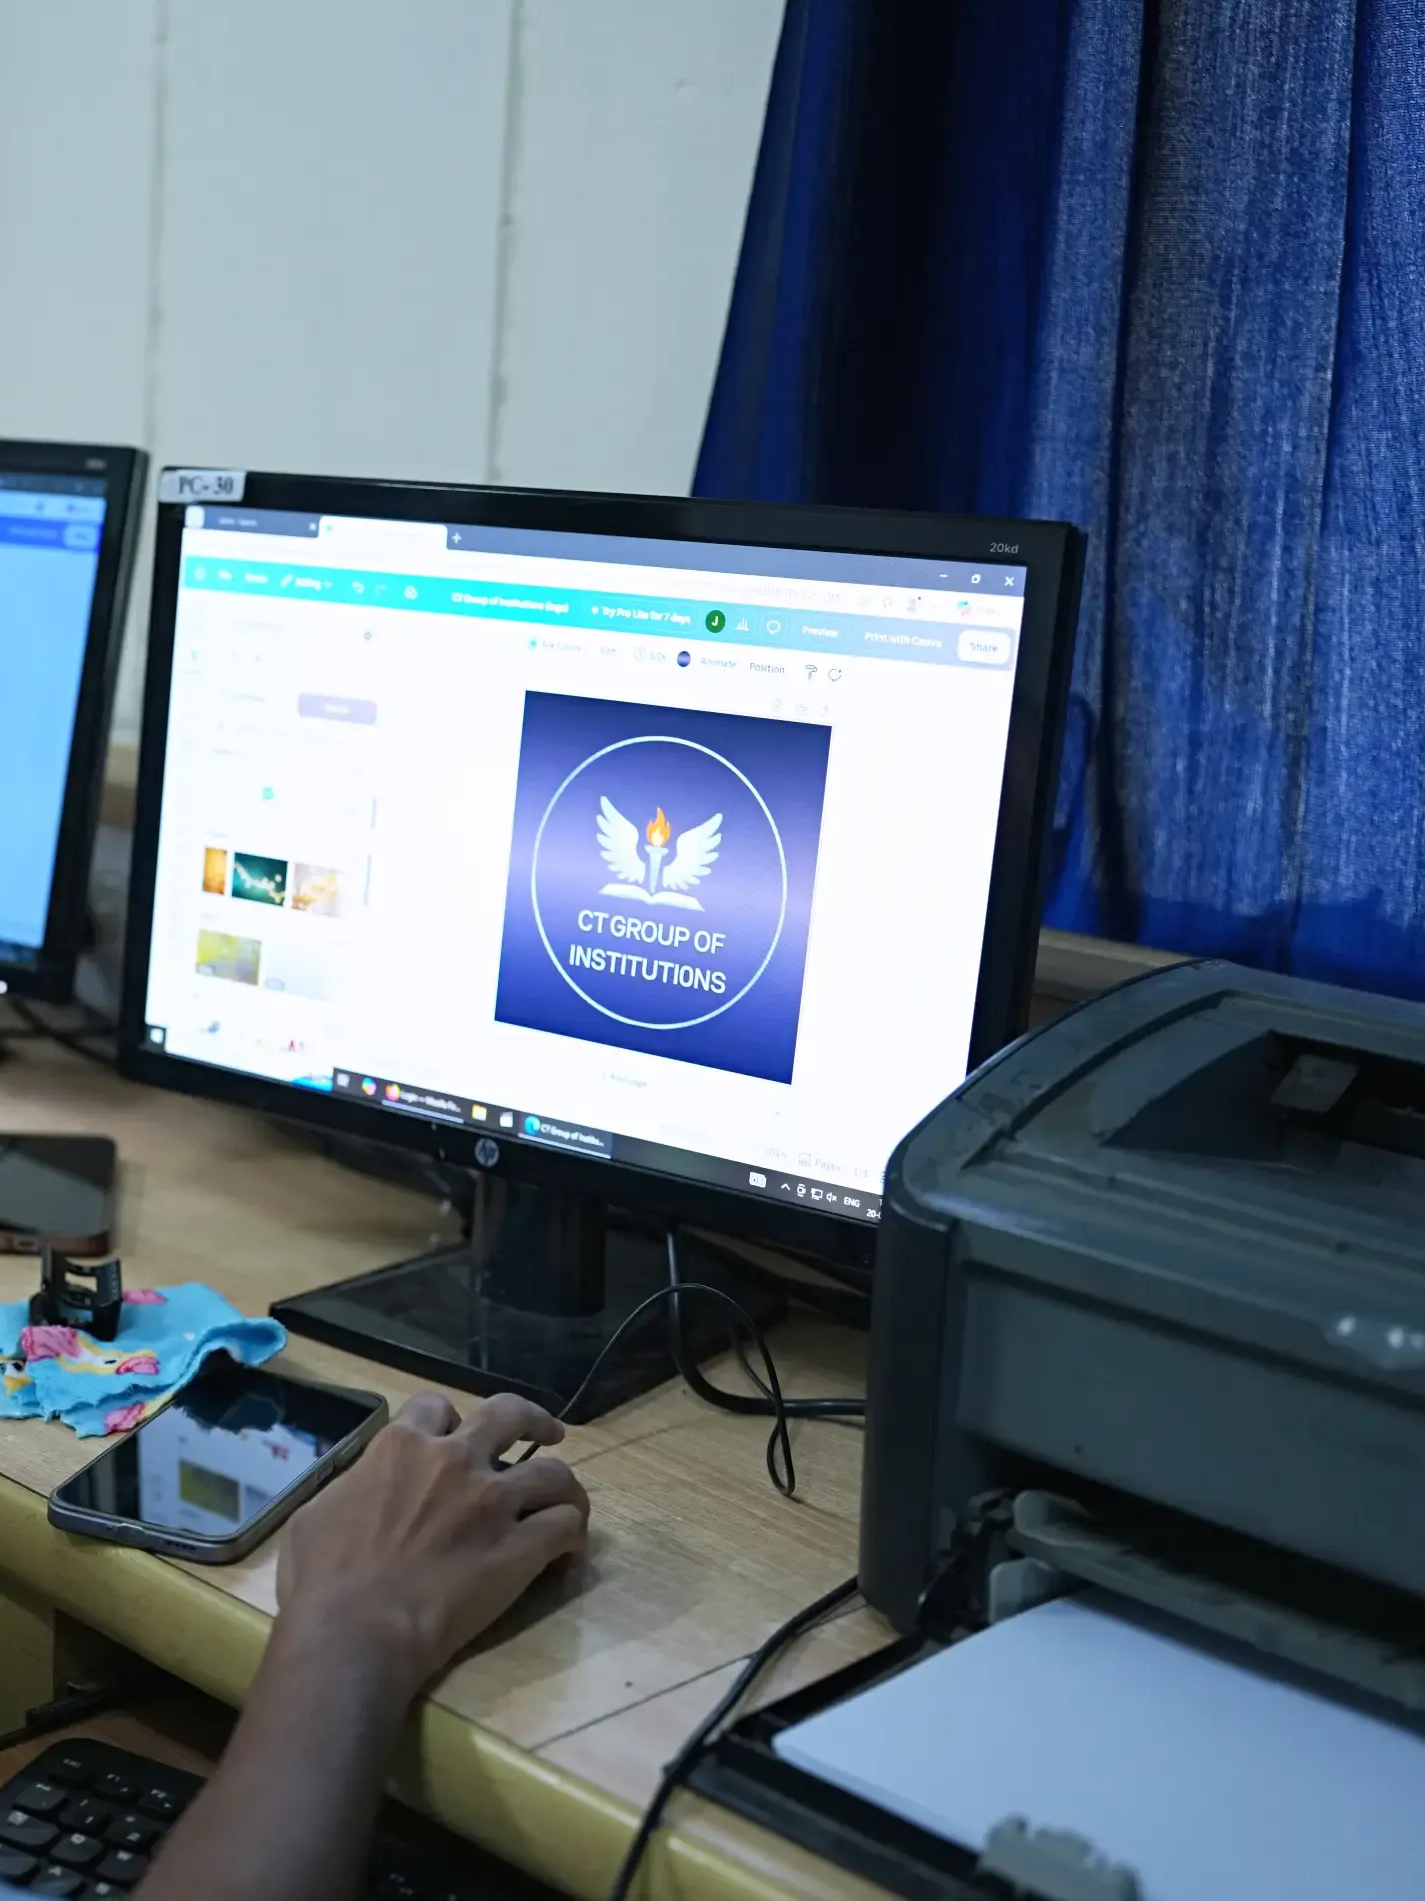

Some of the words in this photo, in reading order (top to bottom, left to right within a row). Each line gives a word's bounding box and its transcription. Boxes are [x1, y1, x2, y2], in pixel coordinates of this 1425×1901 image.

[989, 541, 1020, 555] 20kd
[970, 642, 998, 653] Share
[749, 661, 785, 675] Position
[577, 909, 609, 934] CT
[610, 915, 691, 948] GROUP
[693, 931, 726, 955] OF
[568, 944, 727, 994] INSTITUTIONS
[814, 1158, 842, 1173] Pages
[843, 1196, 861, 1208] ENG
